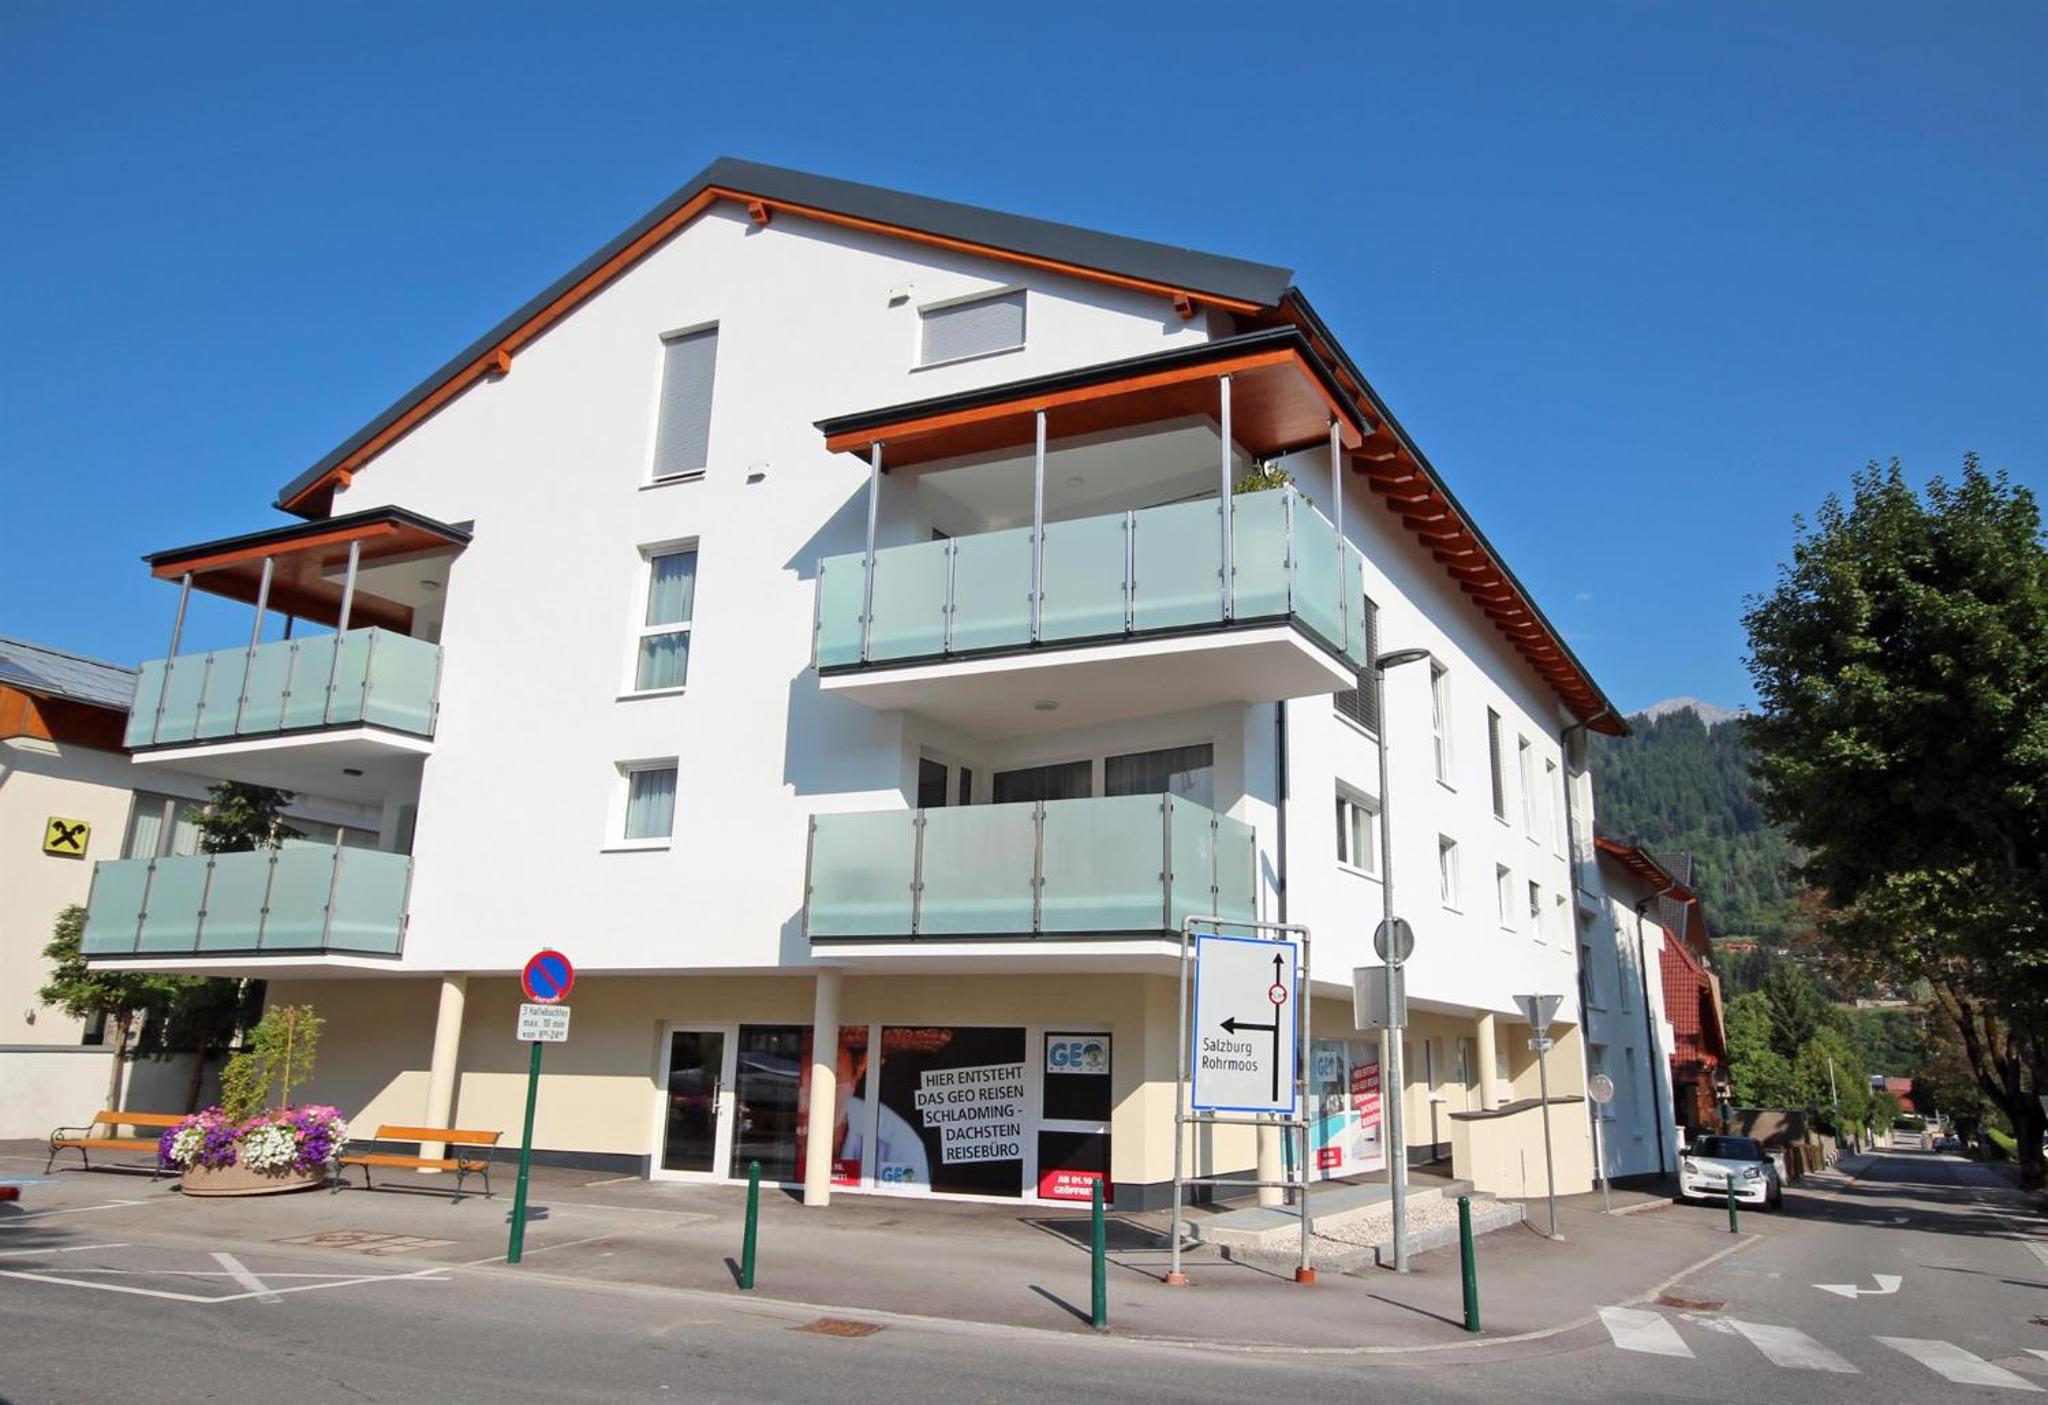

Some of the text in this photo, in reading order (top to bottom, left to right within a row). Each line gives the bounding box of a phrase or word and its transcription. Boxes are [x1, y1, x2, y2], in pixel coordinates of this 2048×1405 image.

[1203, 1037, 1252, 1057] Salzburg
[1202, 1055, 1258, 1072] Rohrmoos
[926, 1066, 1024, 1088] HIER ENTSTEHT
[918, 1084, 1024, 1106] DAS GEO REISEN
[926, 1104, 1014, 1124] SCHLADMING
[946, 1122, 1021, 1141] DACHSTEIN
[946, 1141, 1020, 1160] REISEBÜRO
[1058, 1174, 1070, 1184] AB
